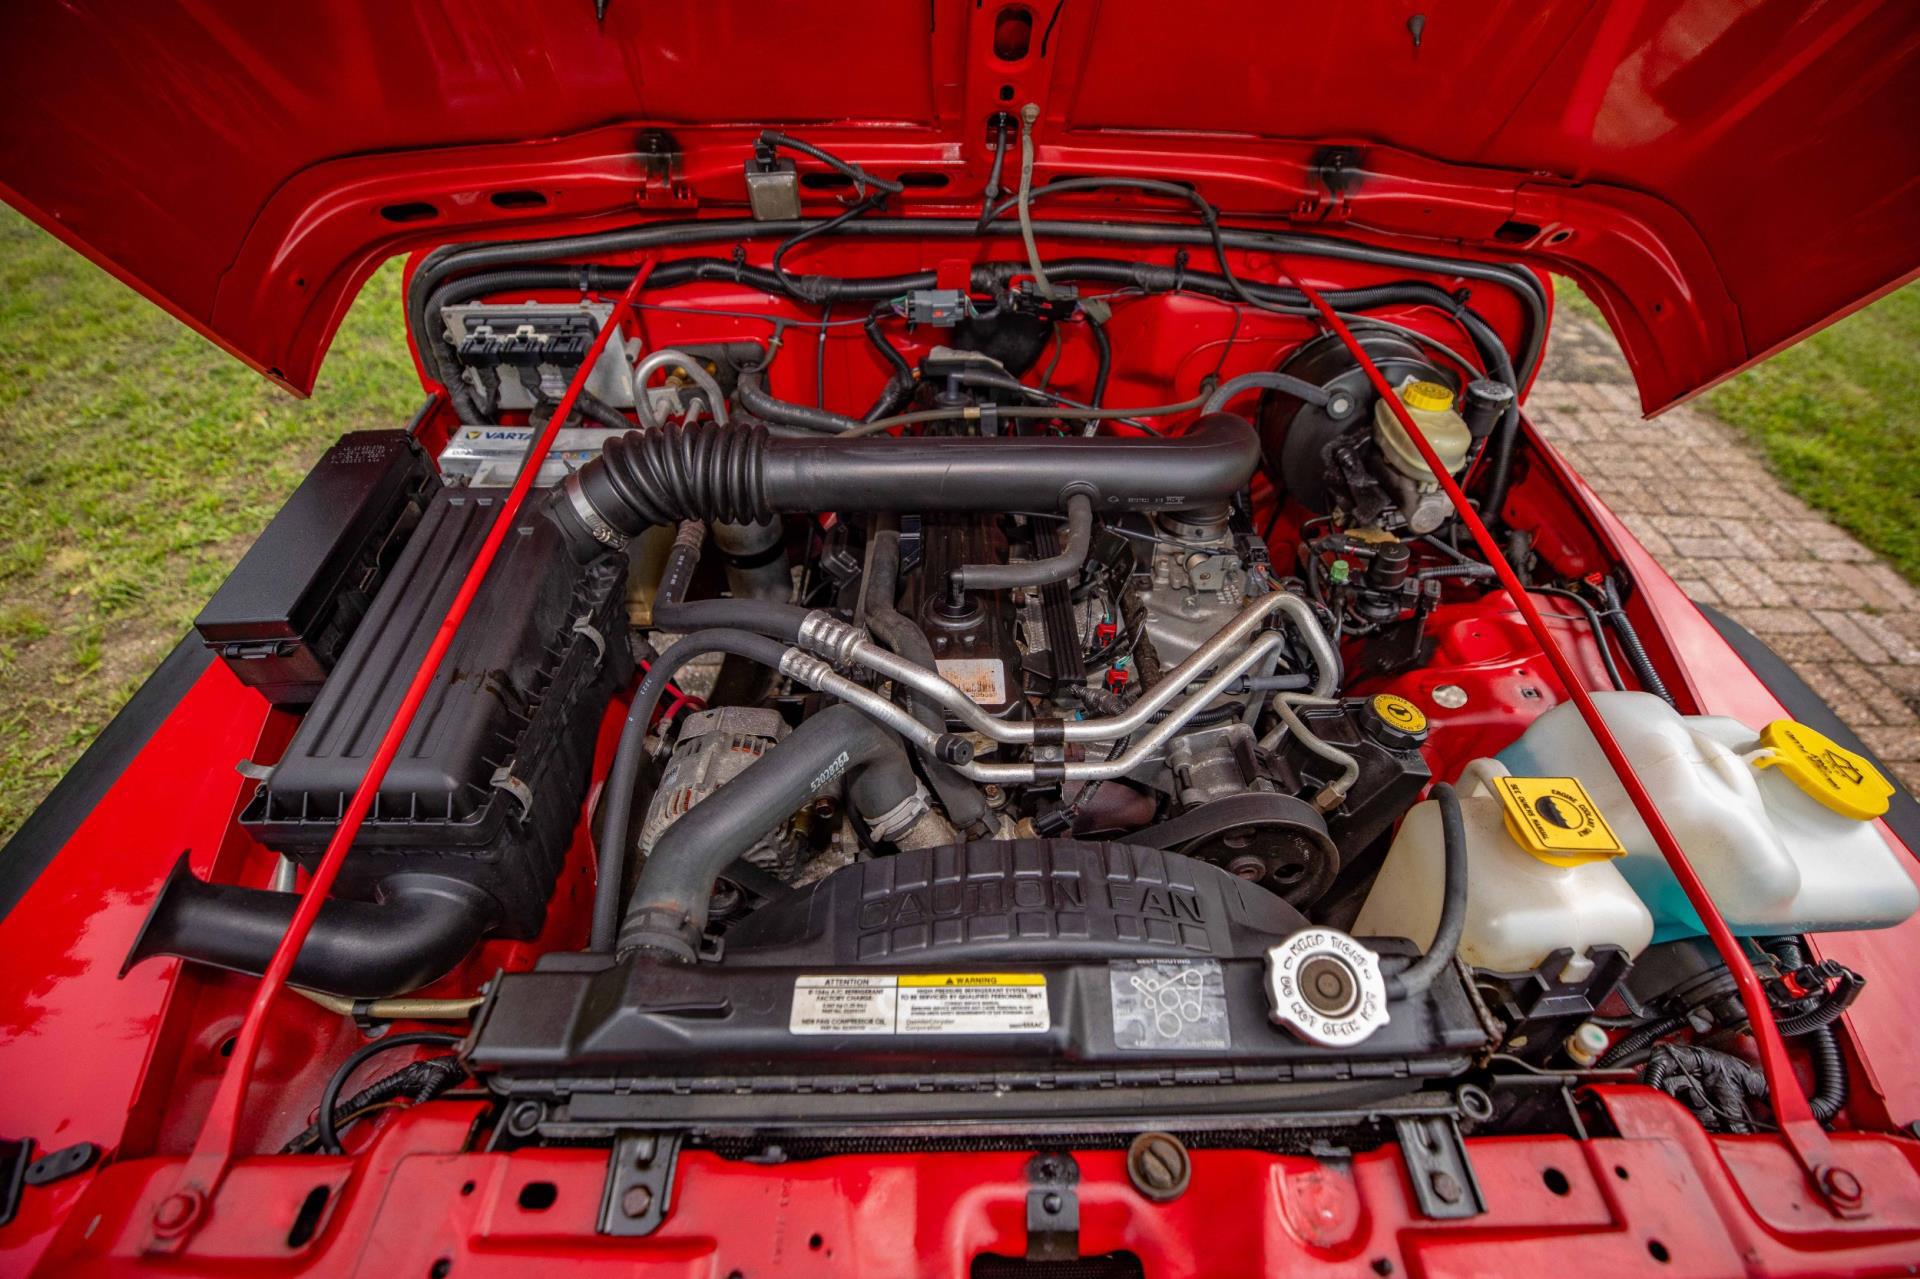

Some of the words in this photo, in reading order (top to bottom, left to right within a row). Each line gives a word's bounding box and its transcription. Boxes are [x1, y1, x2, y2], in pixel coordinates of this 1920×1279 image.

[485, 431, 534, 440] VARTA
[1551, 789, 1577, 803] ENGINE
[1578, 804, 1596, 829] COOLANT
[858, 879, 1087, 930] CAUTION
[1105, 882, 1206, 924] FAN
